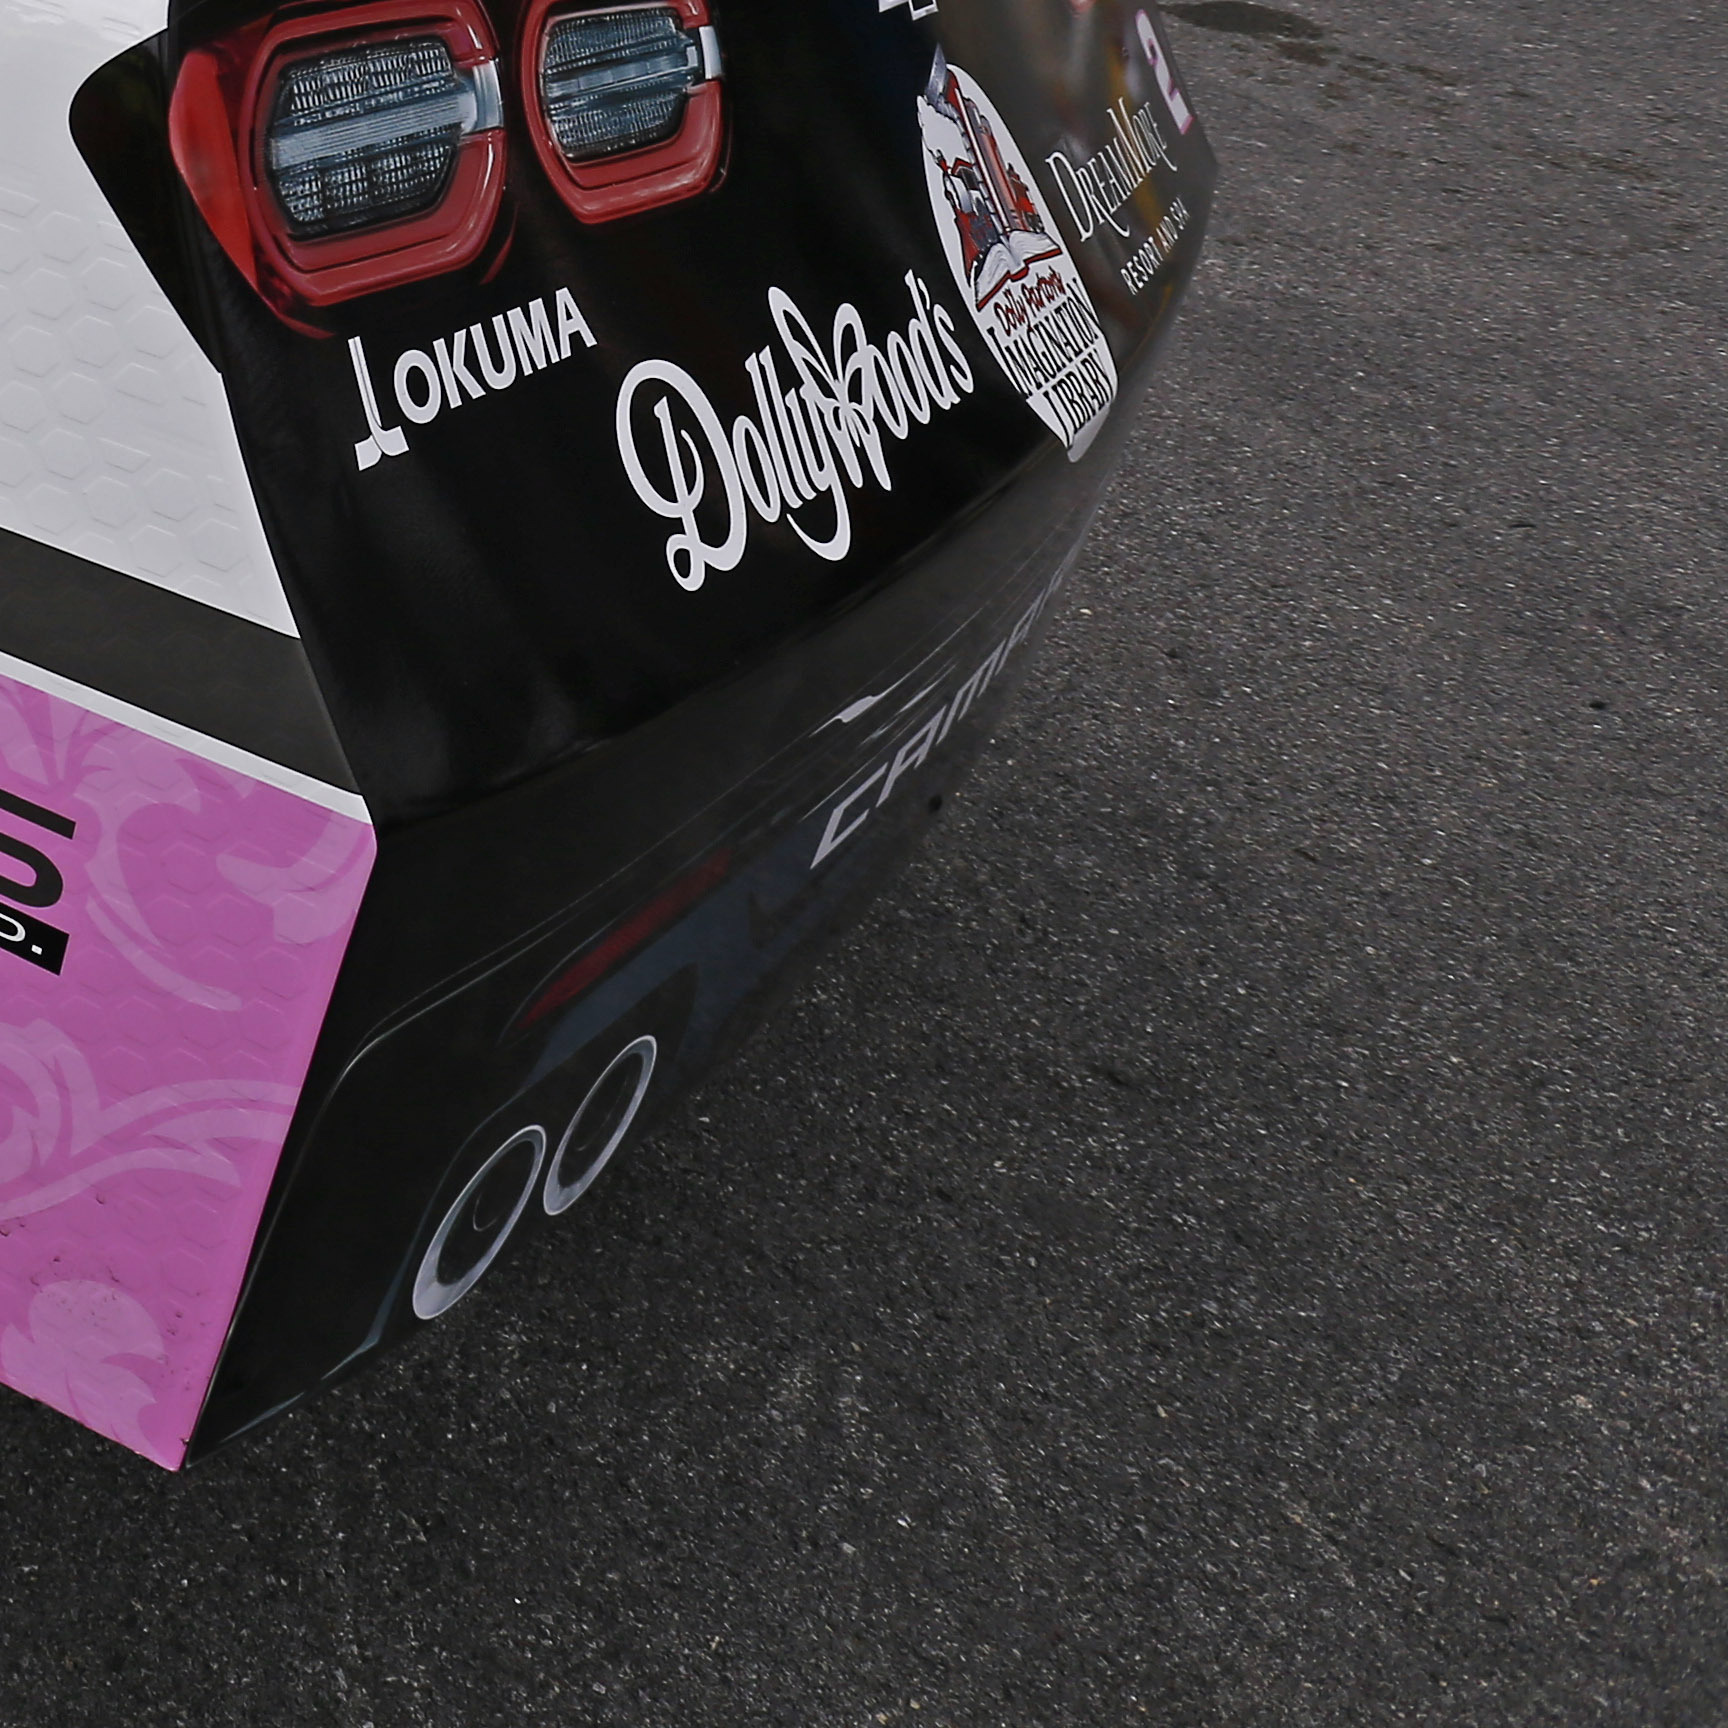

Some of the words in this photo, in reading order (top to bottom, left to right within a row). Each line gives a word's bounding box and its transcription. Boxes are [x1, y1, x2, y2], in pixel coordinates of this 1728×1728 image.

[1137, 9, 1193, 135] 2
[1120, 235, 1164, 296] RESORT
[1155, 215, 1178, 254] AND
[1169, 195, 1192, 231] SPA
[347, 287, 597, 472] LOKUMA
[987, 277, 1100, 399] IMAGINATION
[1043, 349, 1114, 447] LIBRARY
